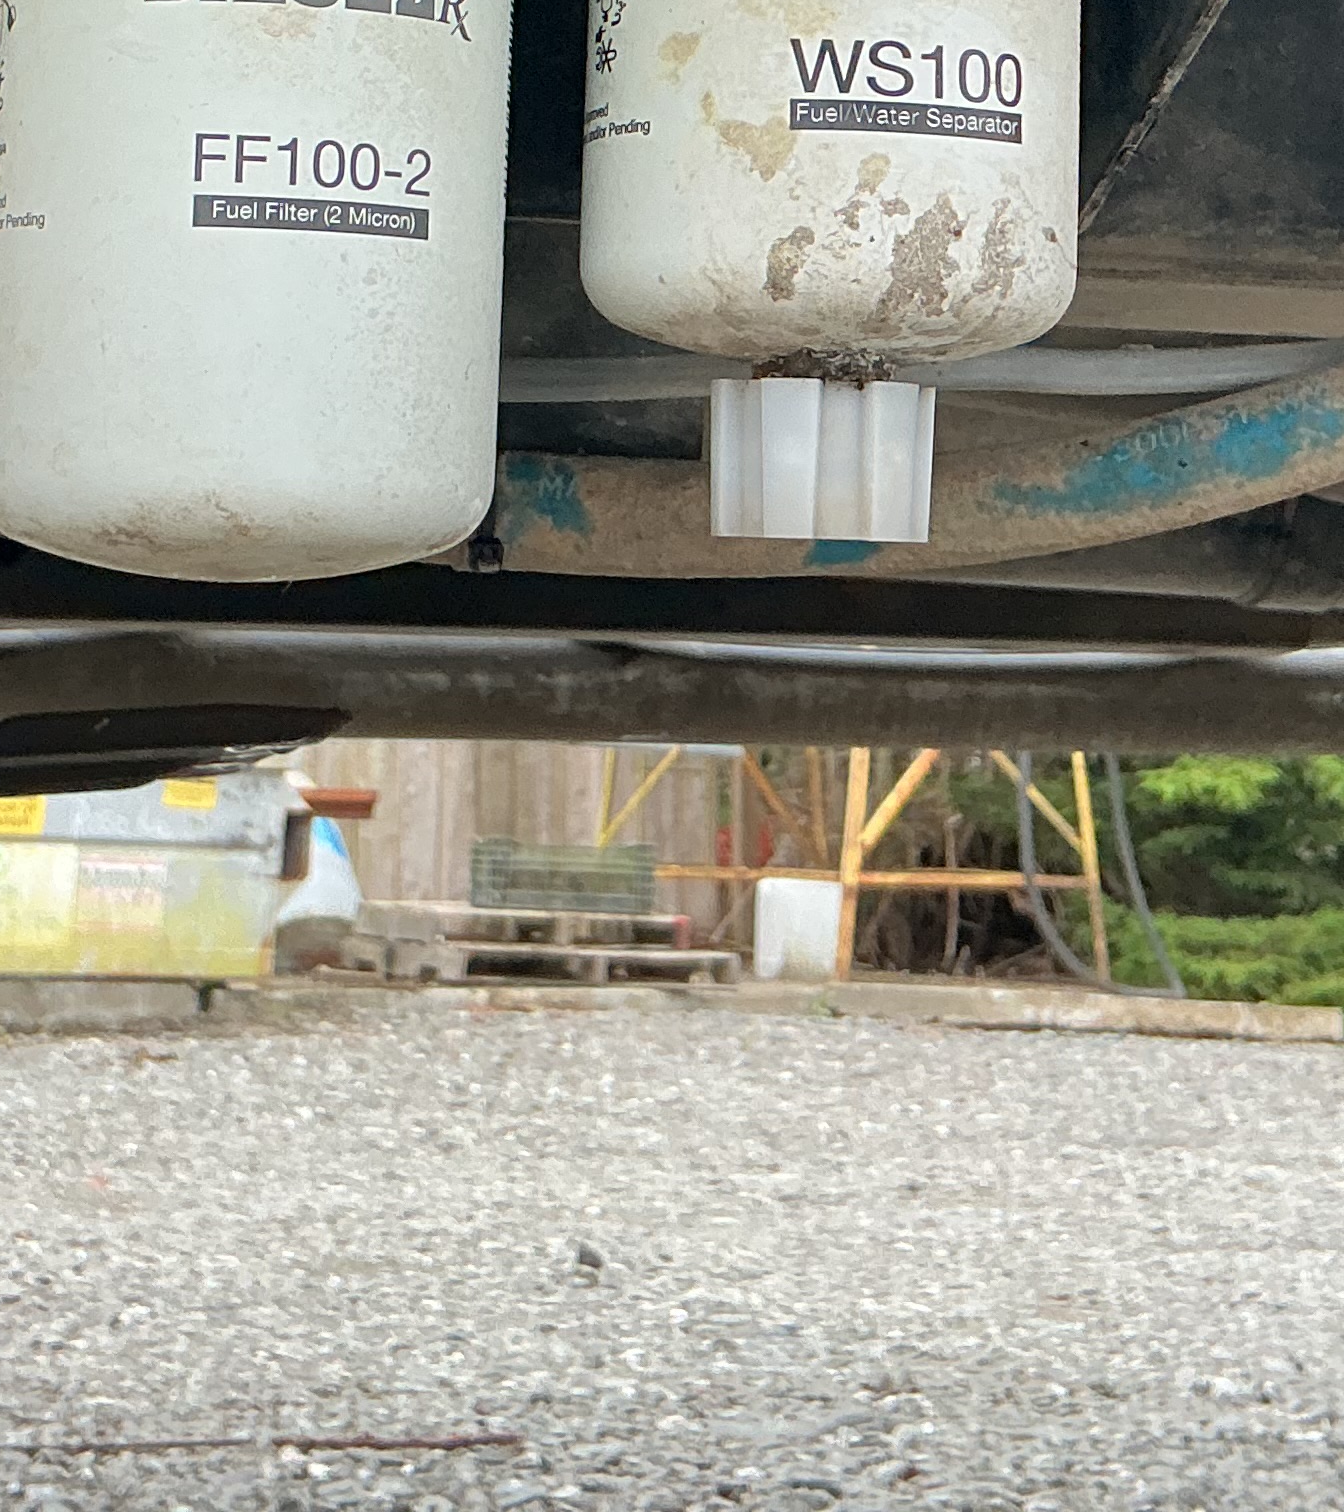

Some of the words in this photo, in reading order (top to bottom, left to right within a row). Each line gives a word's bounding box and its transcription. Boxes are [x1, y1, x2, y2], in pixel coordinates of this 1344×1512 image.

[789, 38, 1022, 108] WS100
[608, 119, 651, 136] Pending
[926, 108, 1019, 137] Separator
[193, 132, 432, 197] FF100-2
[6, 212, 45, 230] Pending
[211, 199, 258, 222] Fuel
[264, 202, 319, 224] Filter
[323, 204, 342, 227] (2
[347, 206, 417, 233] Micron)
